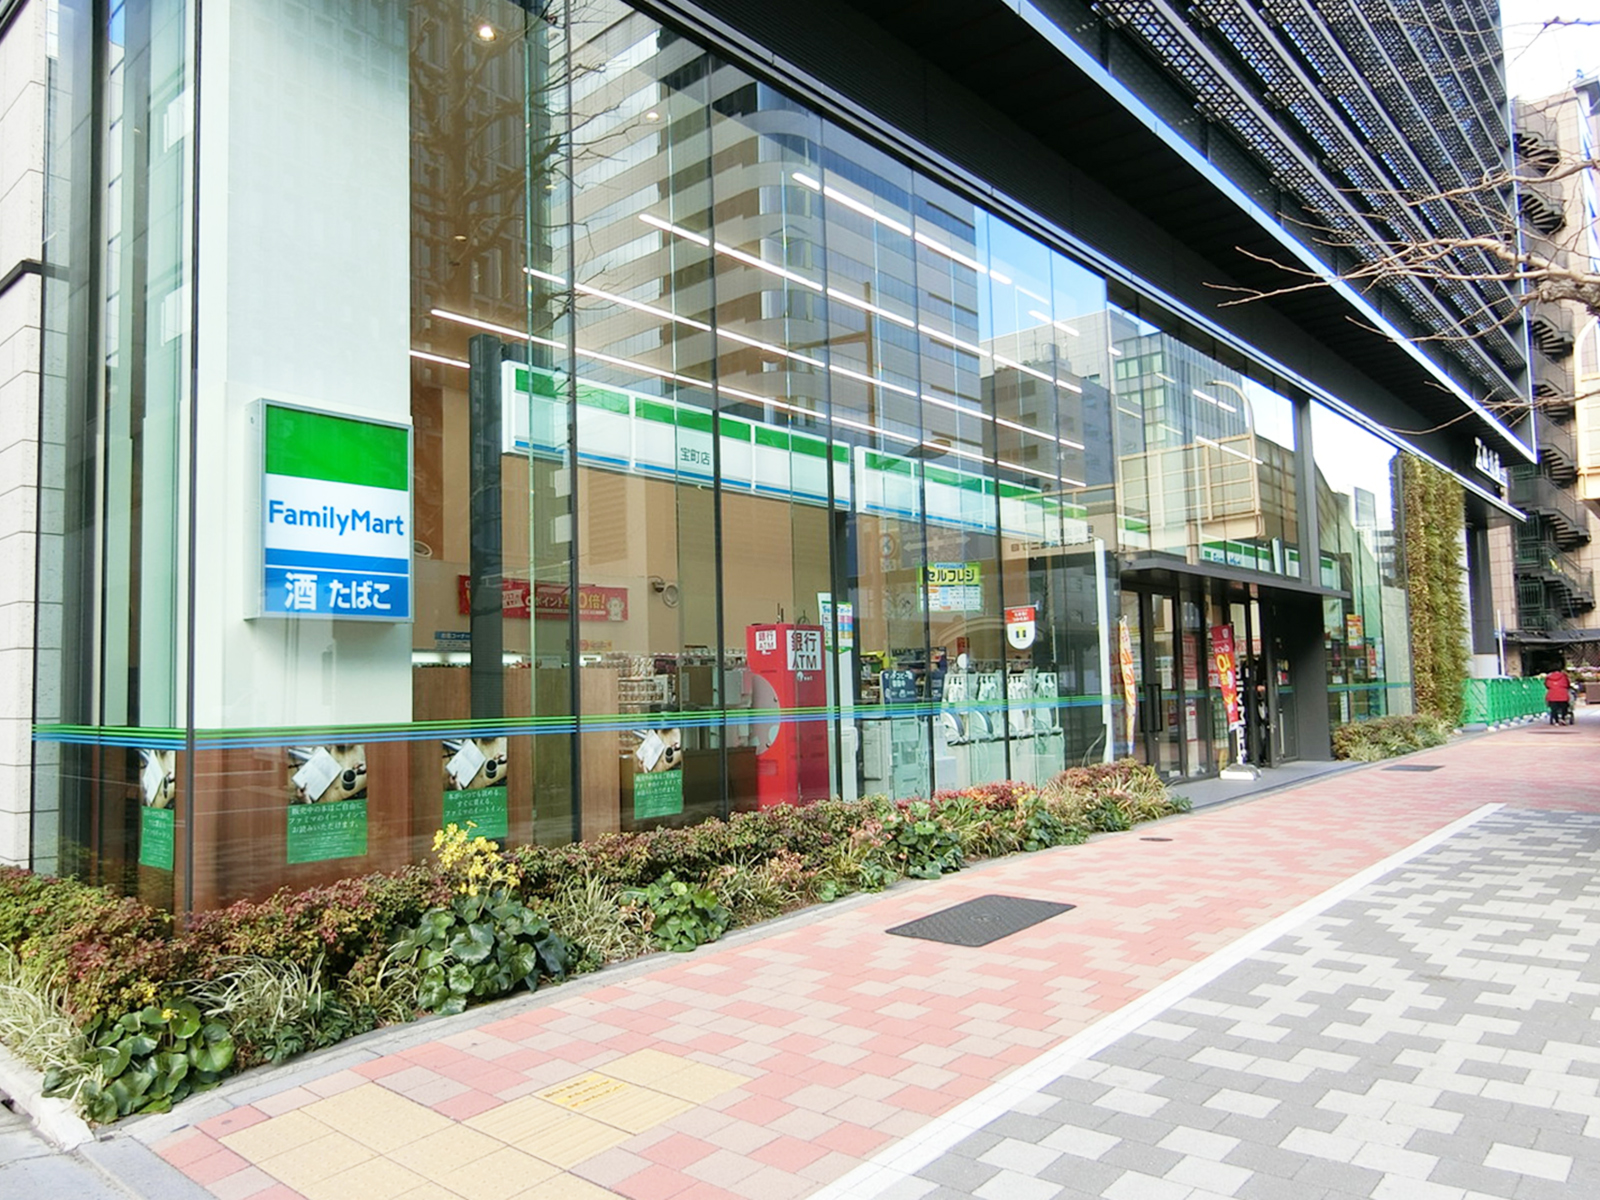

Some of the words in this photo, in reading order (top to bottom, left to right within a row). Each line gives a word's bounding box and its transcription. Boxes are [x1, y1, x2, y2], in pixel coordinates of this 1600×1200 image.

[680, 447, 711, 466] 宝町店
[268, 499, 405, 537] FamilyMart
[927, 568, 975, 583] セルフレジ
[284, 571, 318, 611] 酒
[329, 579, 391, 610] たばこ
[758, 631, 774, 642] 銀行
[790, 632, 817, 652] 銀行
[792, 654, 817, 669] ATM
[291, 803, 364, 815] 販売中の本はご自由に
[289, 811, 367, 825] ファミマのイートインで
[291, 821, 359, 834] お読みいただけます。
